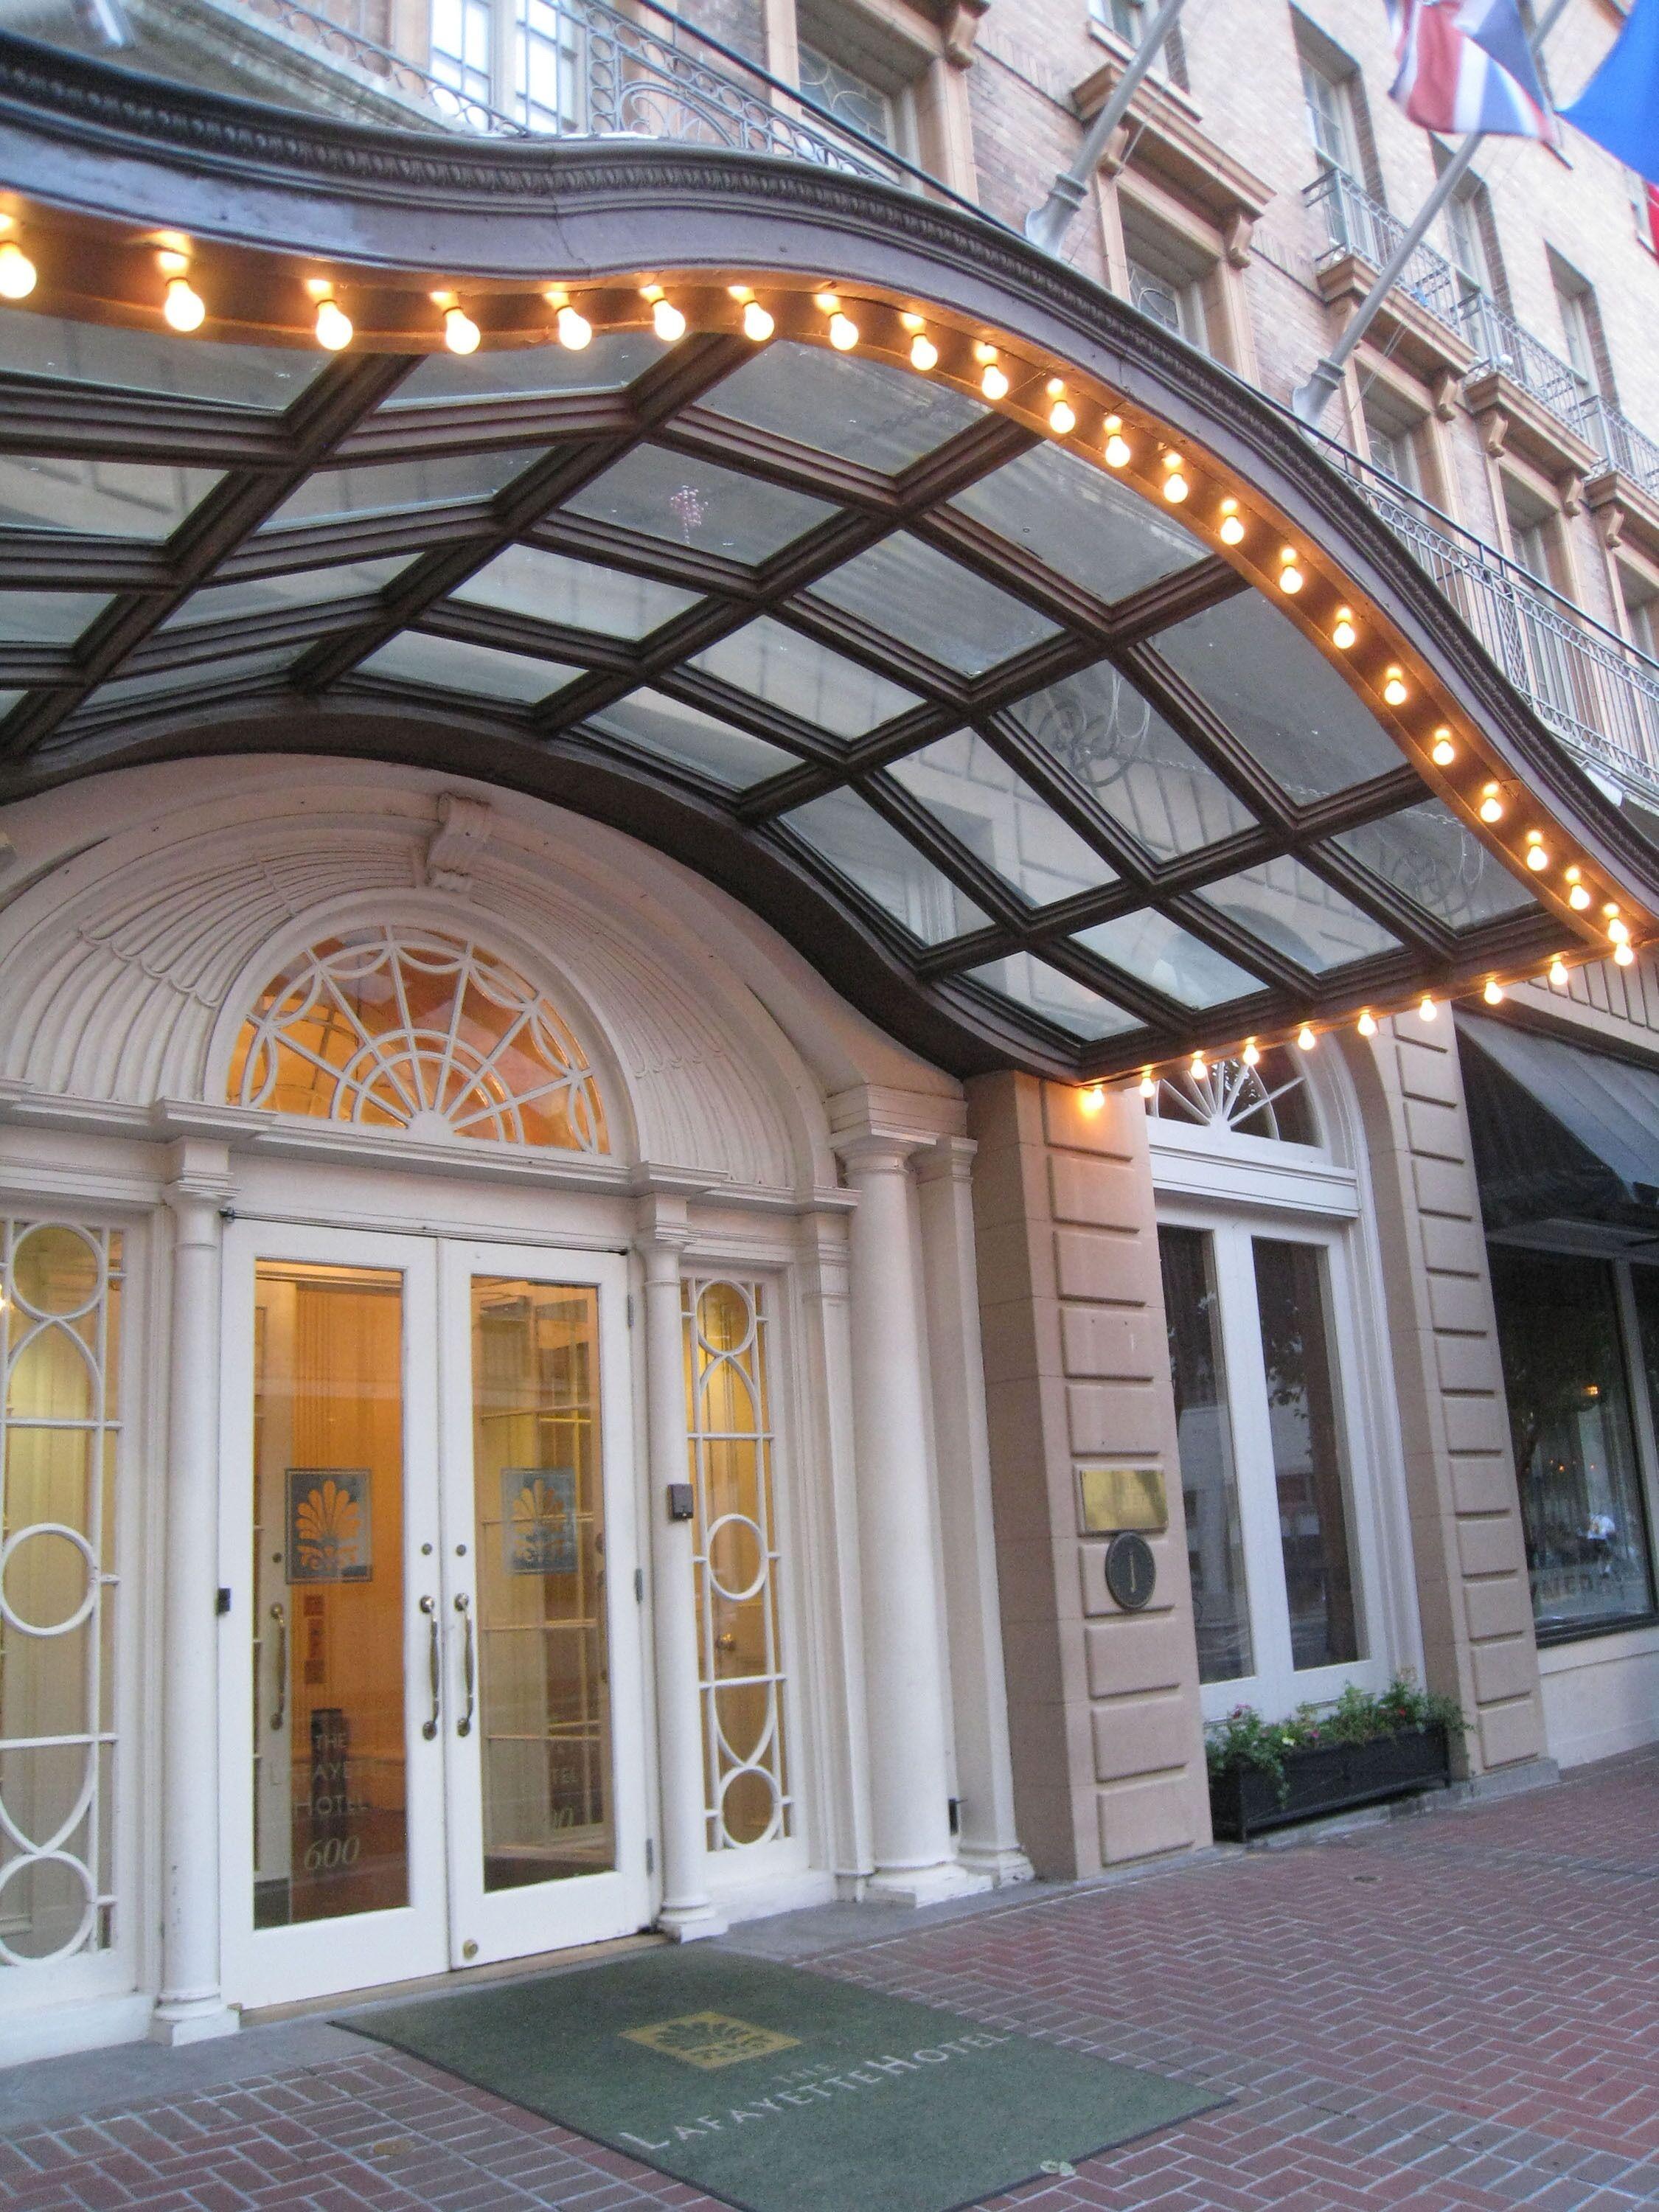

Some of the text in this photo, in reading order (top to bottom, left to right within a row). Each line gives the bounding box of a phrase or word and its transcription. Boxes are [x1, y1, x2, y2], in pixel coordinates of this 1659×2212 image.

[304, 1835, 360, 1871] 600
[619, 2033, 1011, 2150] LAFAYETTE HOTEL
[771, 2063, 836, 2084] THE
